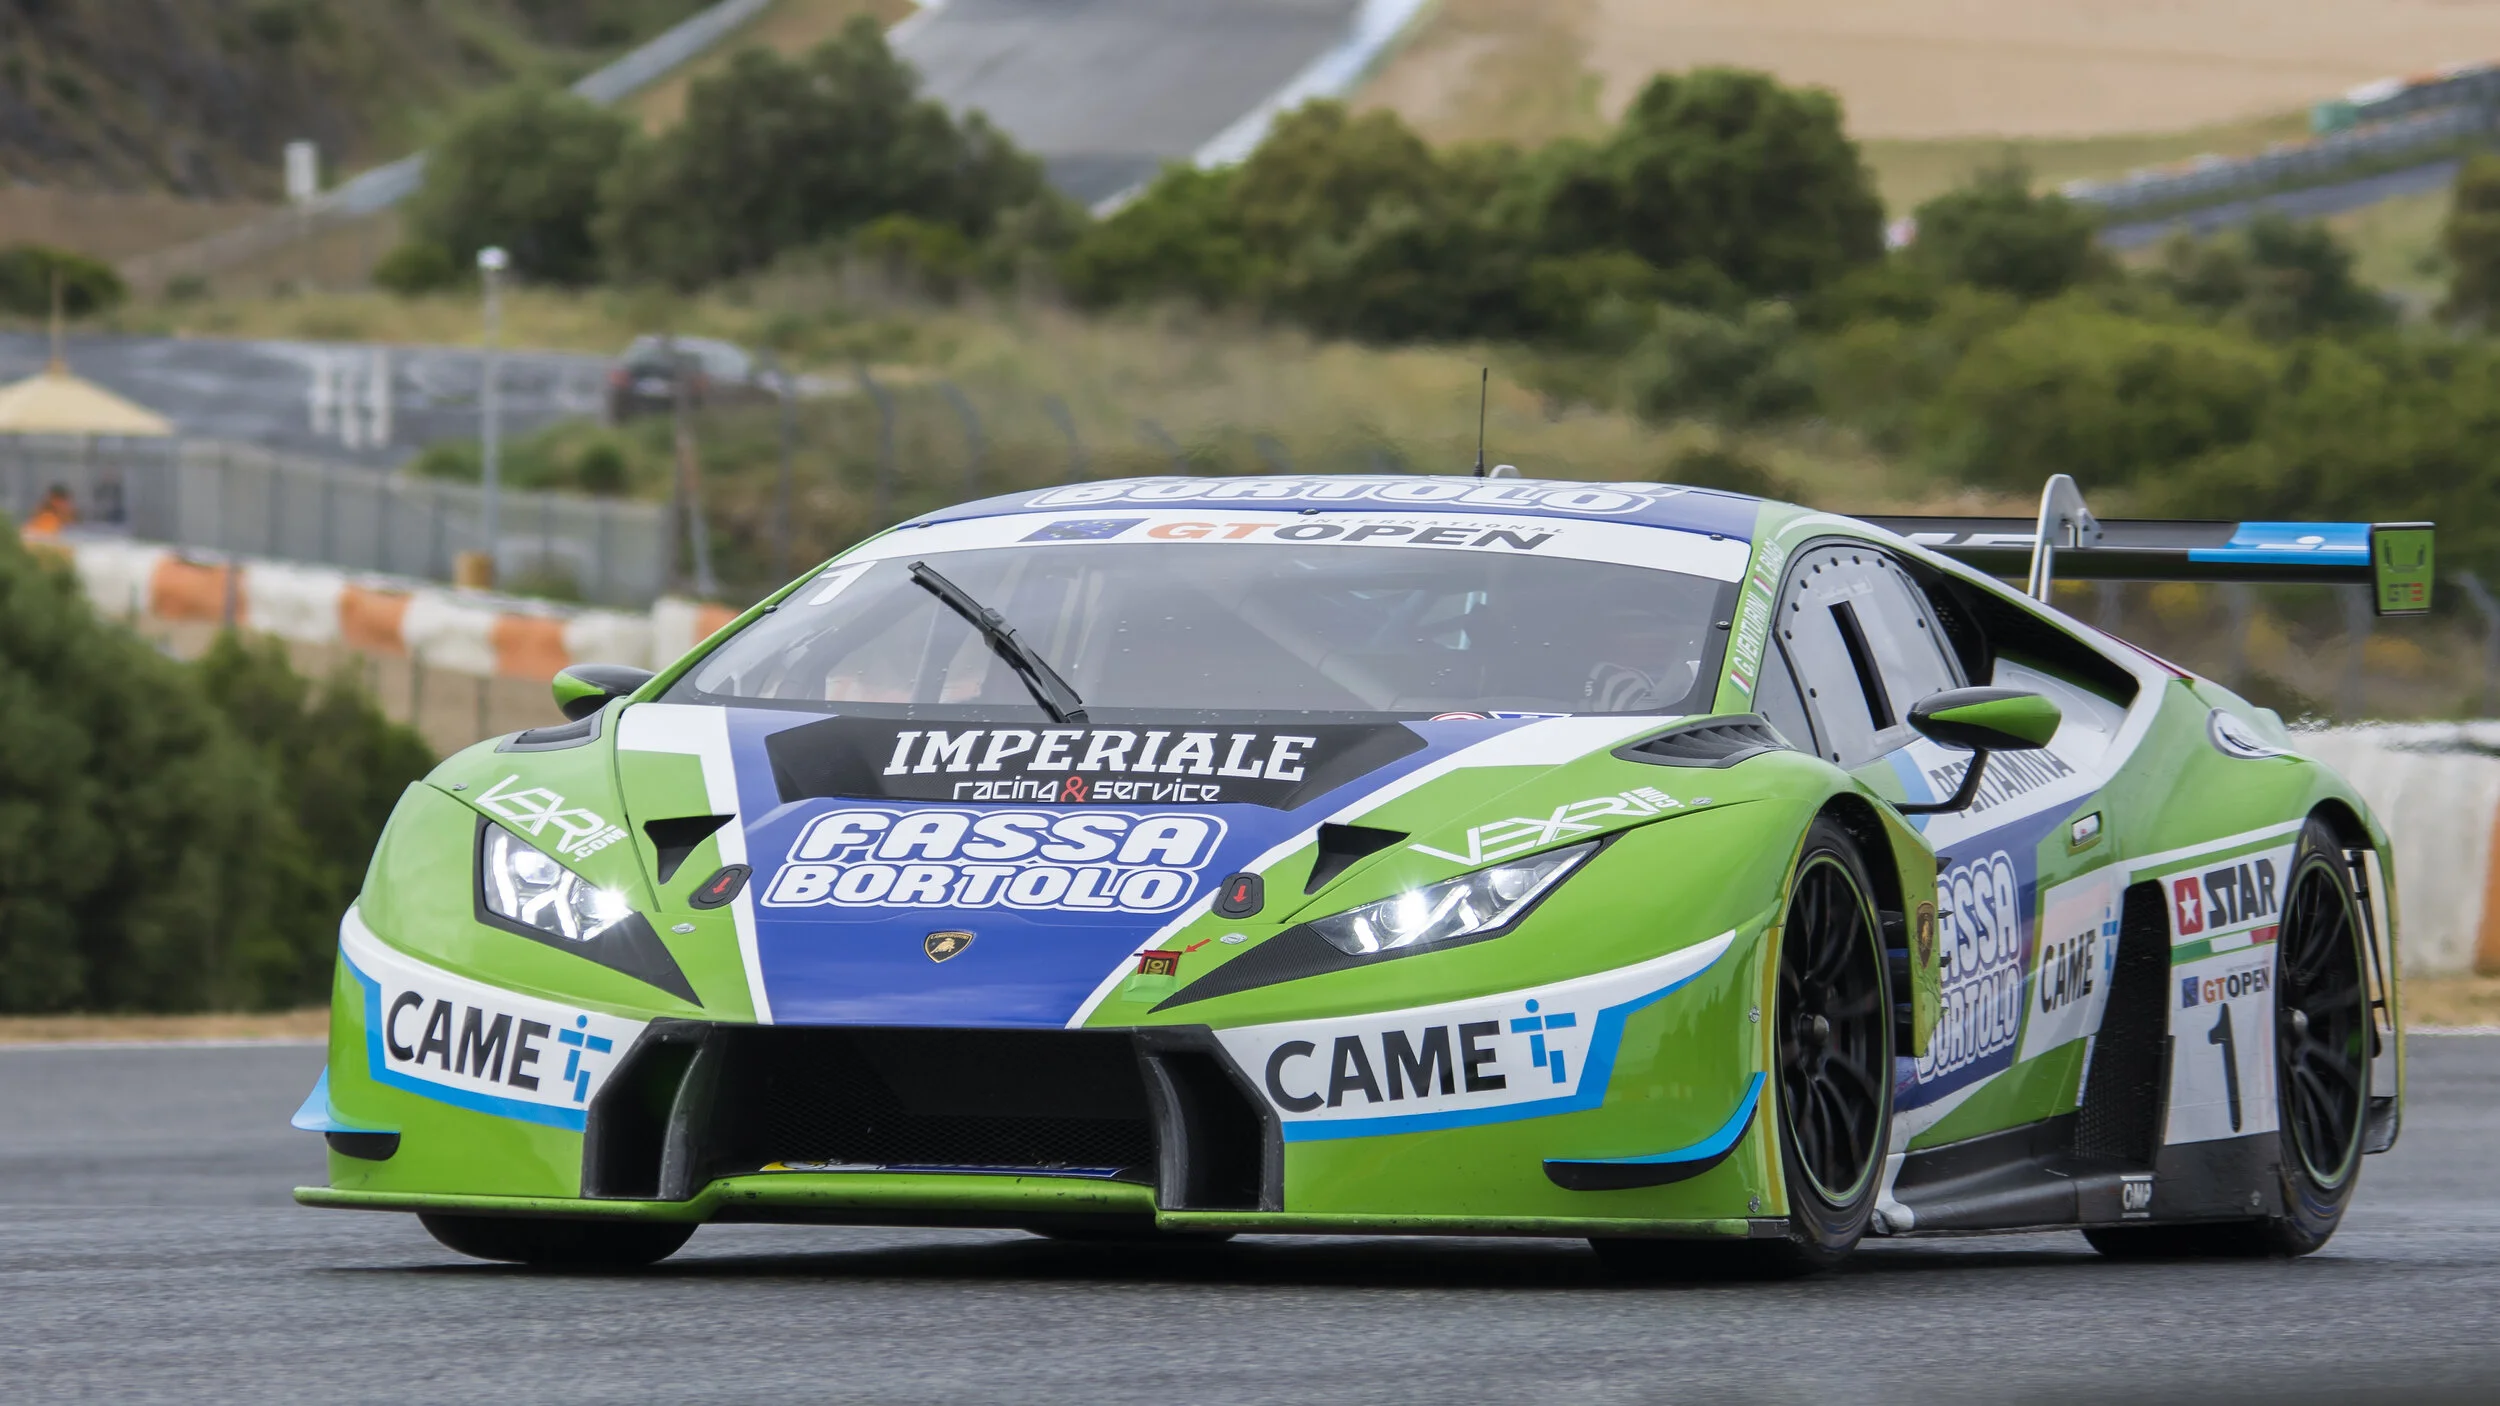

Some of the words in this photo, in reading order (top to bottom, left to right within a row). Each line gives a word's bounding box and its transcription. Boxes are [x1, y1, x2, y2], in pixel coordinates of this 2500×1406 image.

[1028, 476, 1650, 512] BORTOLO
[1300, 517, 1565, 534] INTERNATIONAL
[808, 560, 877, 606] 1
[883, 729, 1317, 782] IMPERIALE
[792, 810, 1222, 867] FASSA
[770, 862, 1194, 911] BORTOLO
[1936, 854, 2020, 983] ASSA
[2203, 858, 2278, 930] STAR
[2041, 929, 2096, 1014] CAME
[386, 990, 551, 1092] CAME
[1264, 1020, 1507, 1113] CAME
[2207, 1002, 2243, 1133] 1
